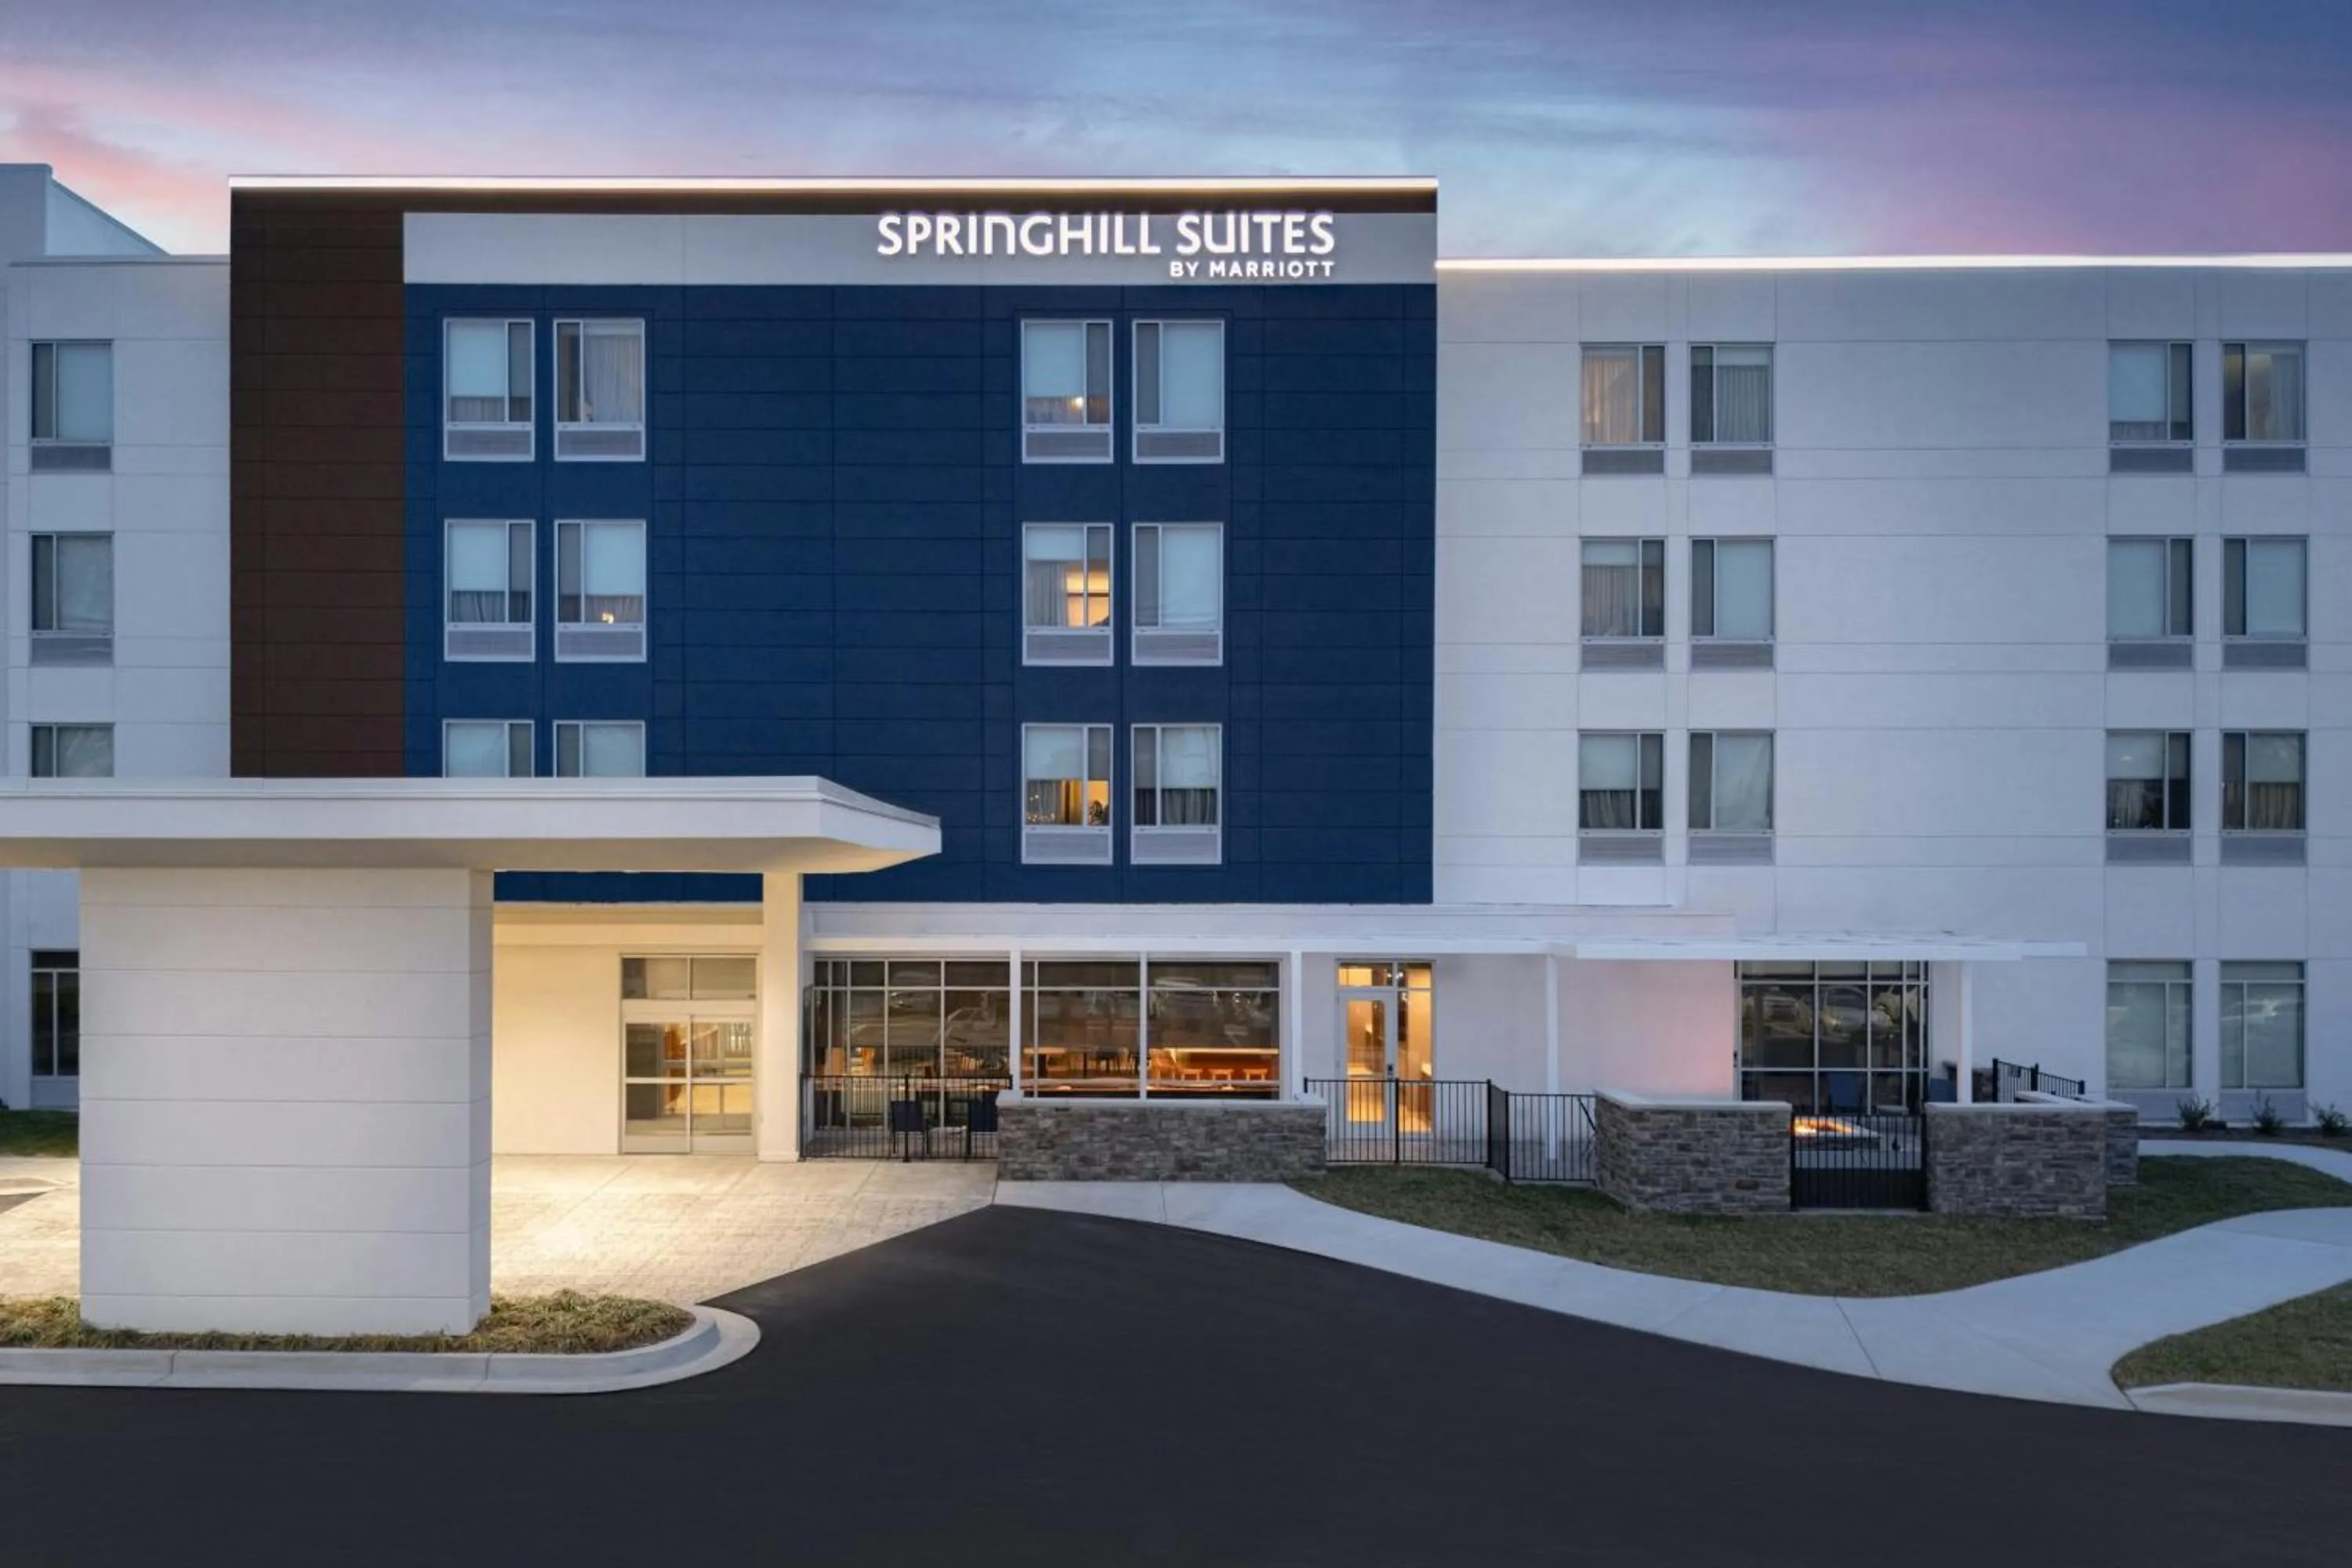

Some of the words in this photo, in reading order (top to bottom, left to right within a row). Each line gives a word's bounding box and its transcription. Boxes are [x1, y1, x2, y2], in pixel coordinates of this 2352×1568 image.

[877, 214, 1162, 256] SPRINGHILL
[1176, 214, 1335, 256] SUITES
[1170, 260, 1199, 278] BY
[1209, 260, 1335, 278] MARRIOTT
